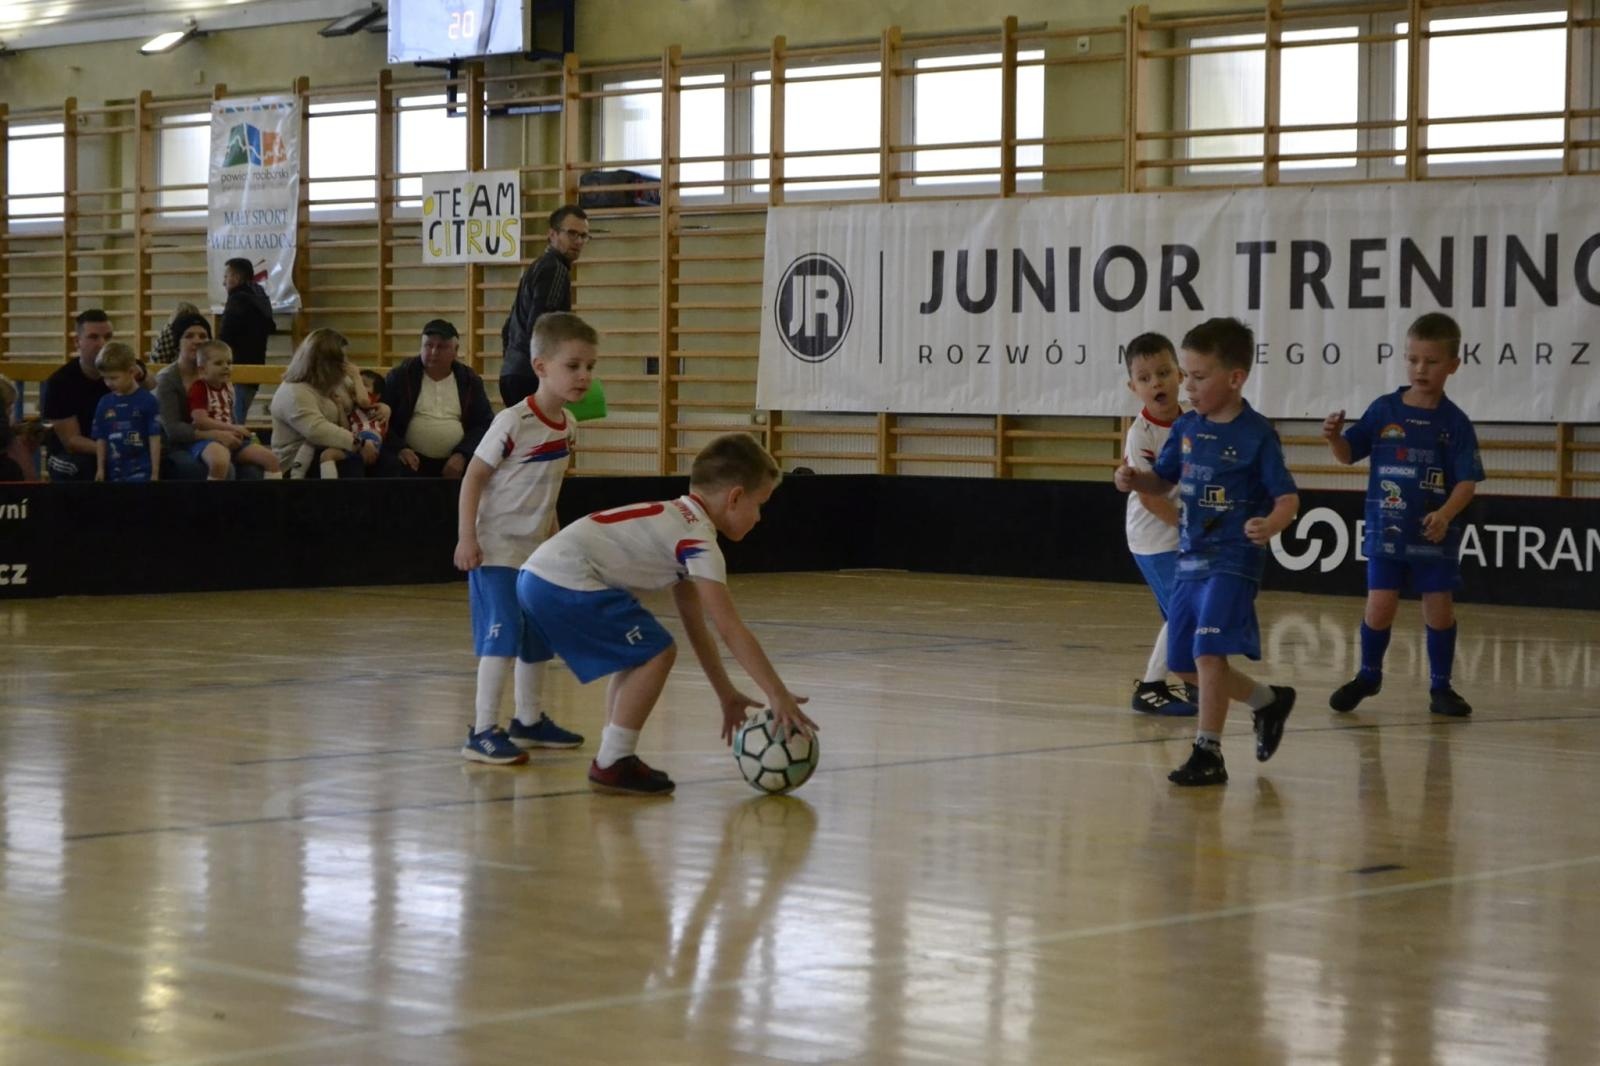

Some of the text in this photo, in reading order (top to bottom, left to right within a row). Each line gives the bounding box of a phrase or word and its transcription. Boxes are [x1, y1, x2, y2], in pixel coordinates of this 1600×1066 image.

[448, 10, 475, 40] 20
[433, 182, 515, 218] TEAM
[252, 208, 289, 226] SPORT
[211, 233, 252, 250] WIELKA
[429, 218, 519, 257] CITRUS
[919, 243, 1205, 315] JUNIOR
[789, 274, 841, 338] JR
[918, 338, 1088, 365] ROZWÓJ
[1377, 341, 1591, 366] PKARZ
